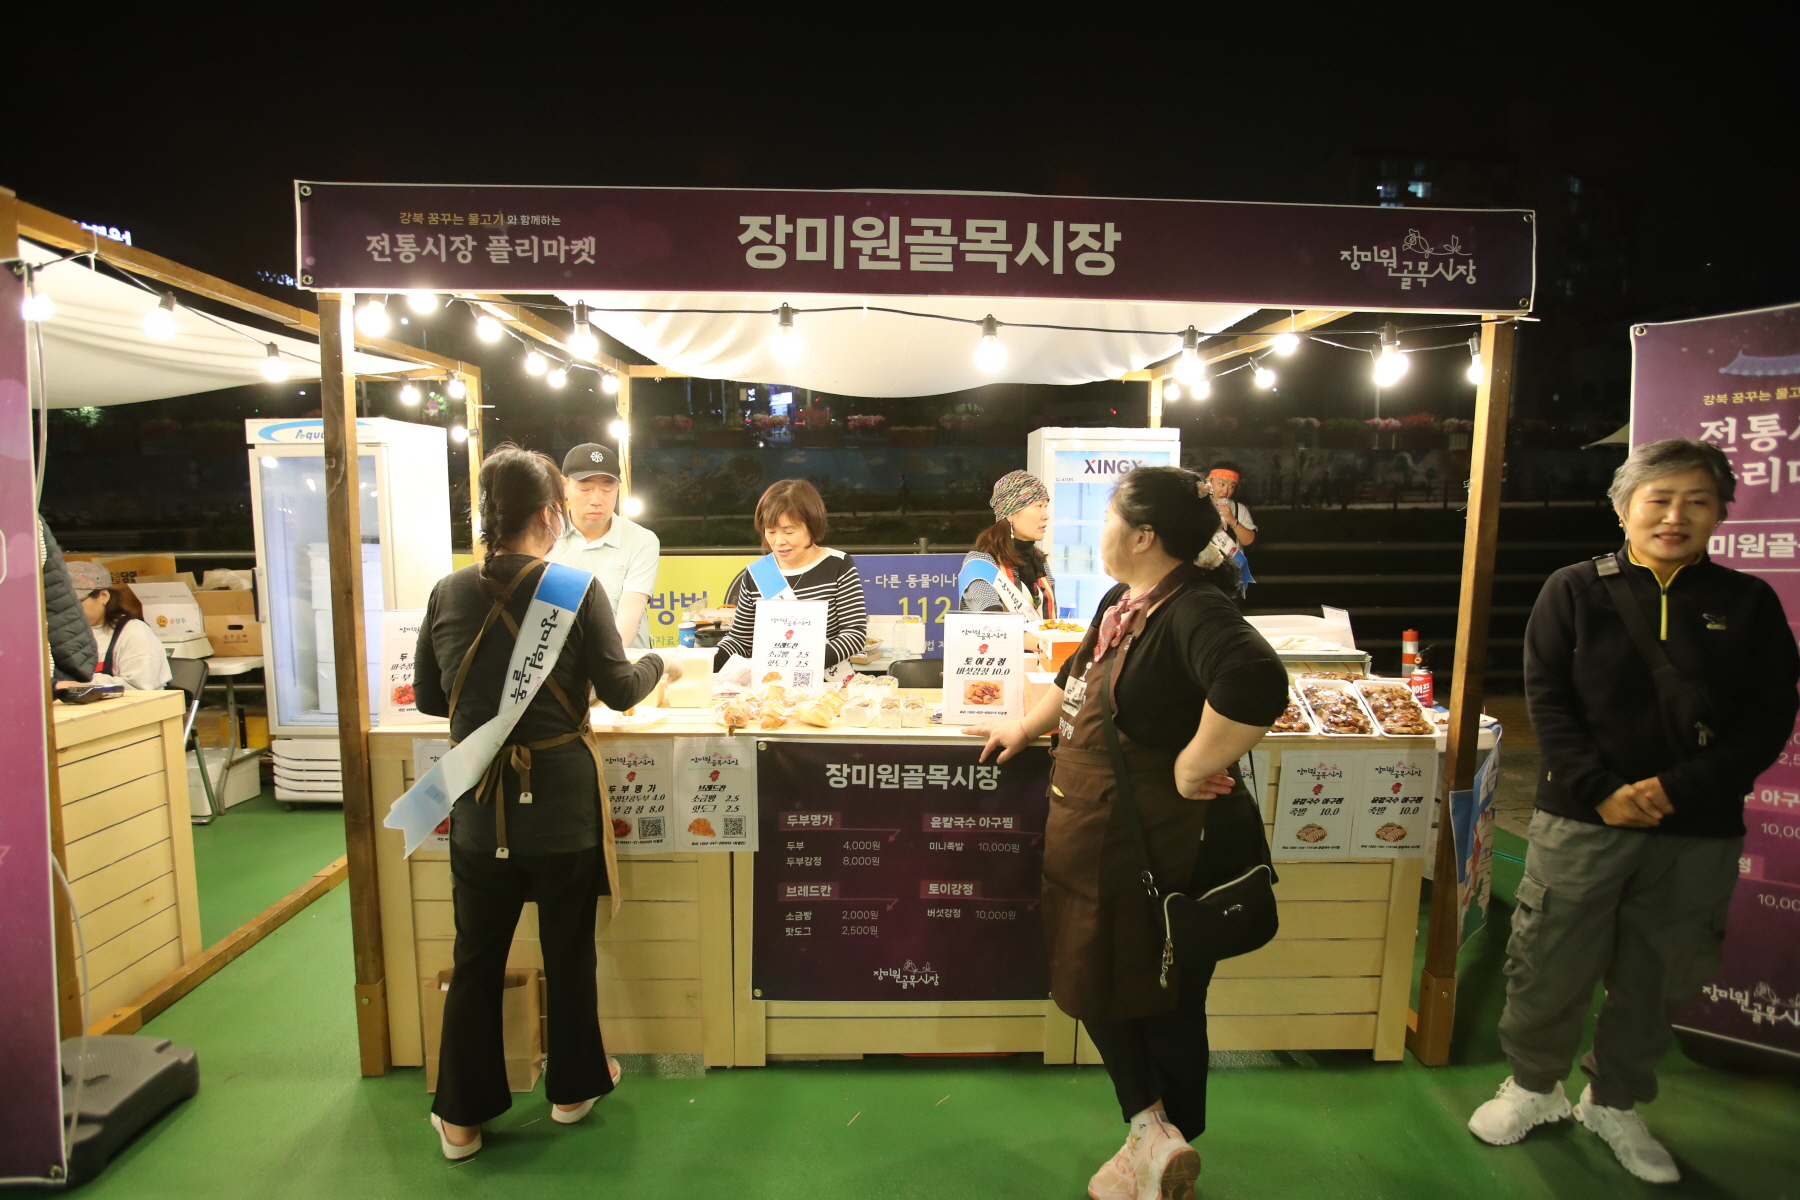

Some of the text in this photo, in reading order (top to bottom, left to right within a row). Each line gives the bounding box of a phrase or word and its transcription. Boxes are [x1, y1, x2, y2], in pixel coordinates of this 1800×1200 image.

[399, 211, 425, 225] 강북
[427, 211, 465, 226] 꿈꾸는
[520, 214, 562, 227] 함께하는
[365, 233, 597, 266] 전통시장 플리마켓
[737, 214, 1122, 277] 장미원골목시장
[1702, 393, 1728, 406] 강북
[1731, 390, 1772, 404] 꿈꾸는
[875, 573, 958, 589] 다른 동물이나
[796, 651, 810, 659] 2.5
[795, 660, 809, 668] 2.5
[991, 668, 1011, 676] 10.0
[825, 763, 1001, 791] 장미원골목시장
[651, 793, 666, 801] 4.0
[724, 794, 741, 802] 2.5
[648, 804, 665, 813] 8.0
[724, 804, 741, 813] 2.5
[1319, 807, 1340, 816] 10.0
[1399, 806, 1420, 815] 10.0
[787, 814, 834, 827] 두부명가
[930, 816, 1014, 829] 윤칼국수 아구찜
[786, 840, 881, 851] 두부 4,000원
[929, 841, 1020, 853] 미니족발 10,000원
[786, 856, 880, 867] 두부강정 8,000원
[785, 884, 832, 898] 브레드칸
[928, 883, 974, 896] 토이강정
[785, 910, 879, 921] 소금빵 2,000원
[927, 908, 1016, 920] 버섯강정 10,000원
[785, 925, 878, 937] 핫도그 2,500원
[873, 968, 940, 989] 장미원골목시장
